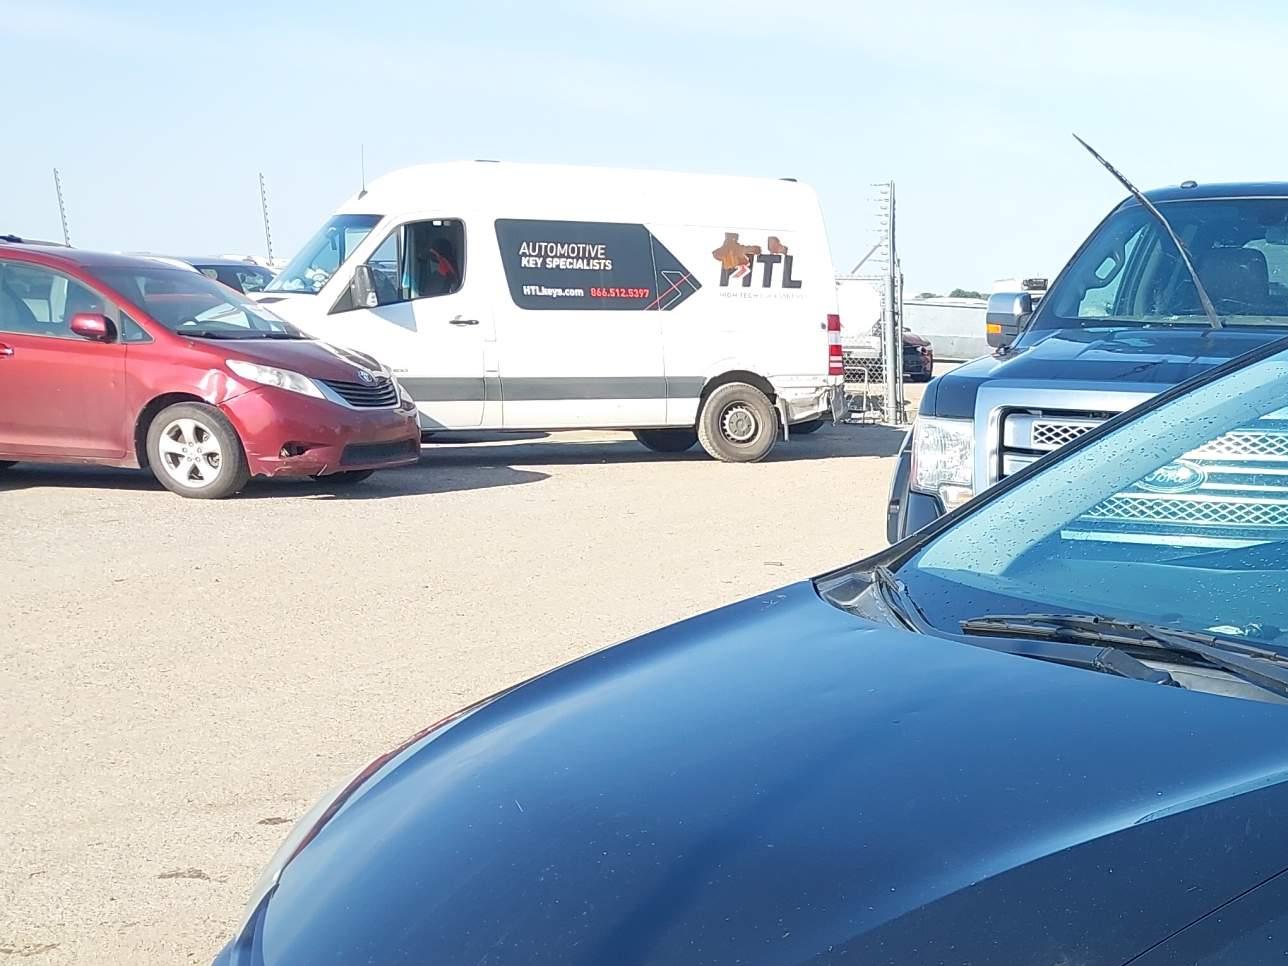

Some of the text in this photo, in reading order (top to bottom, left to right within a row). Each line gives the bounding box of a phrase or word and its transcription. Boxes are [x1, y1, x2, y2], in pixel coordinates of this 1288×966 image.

[519, 241, 606, 259] AUTOMOTIVE
[521, 256, 613, 271] KEY SPECIALISTS
[522, 285, 650, 298] HTLkeys.com 866.512.5397
